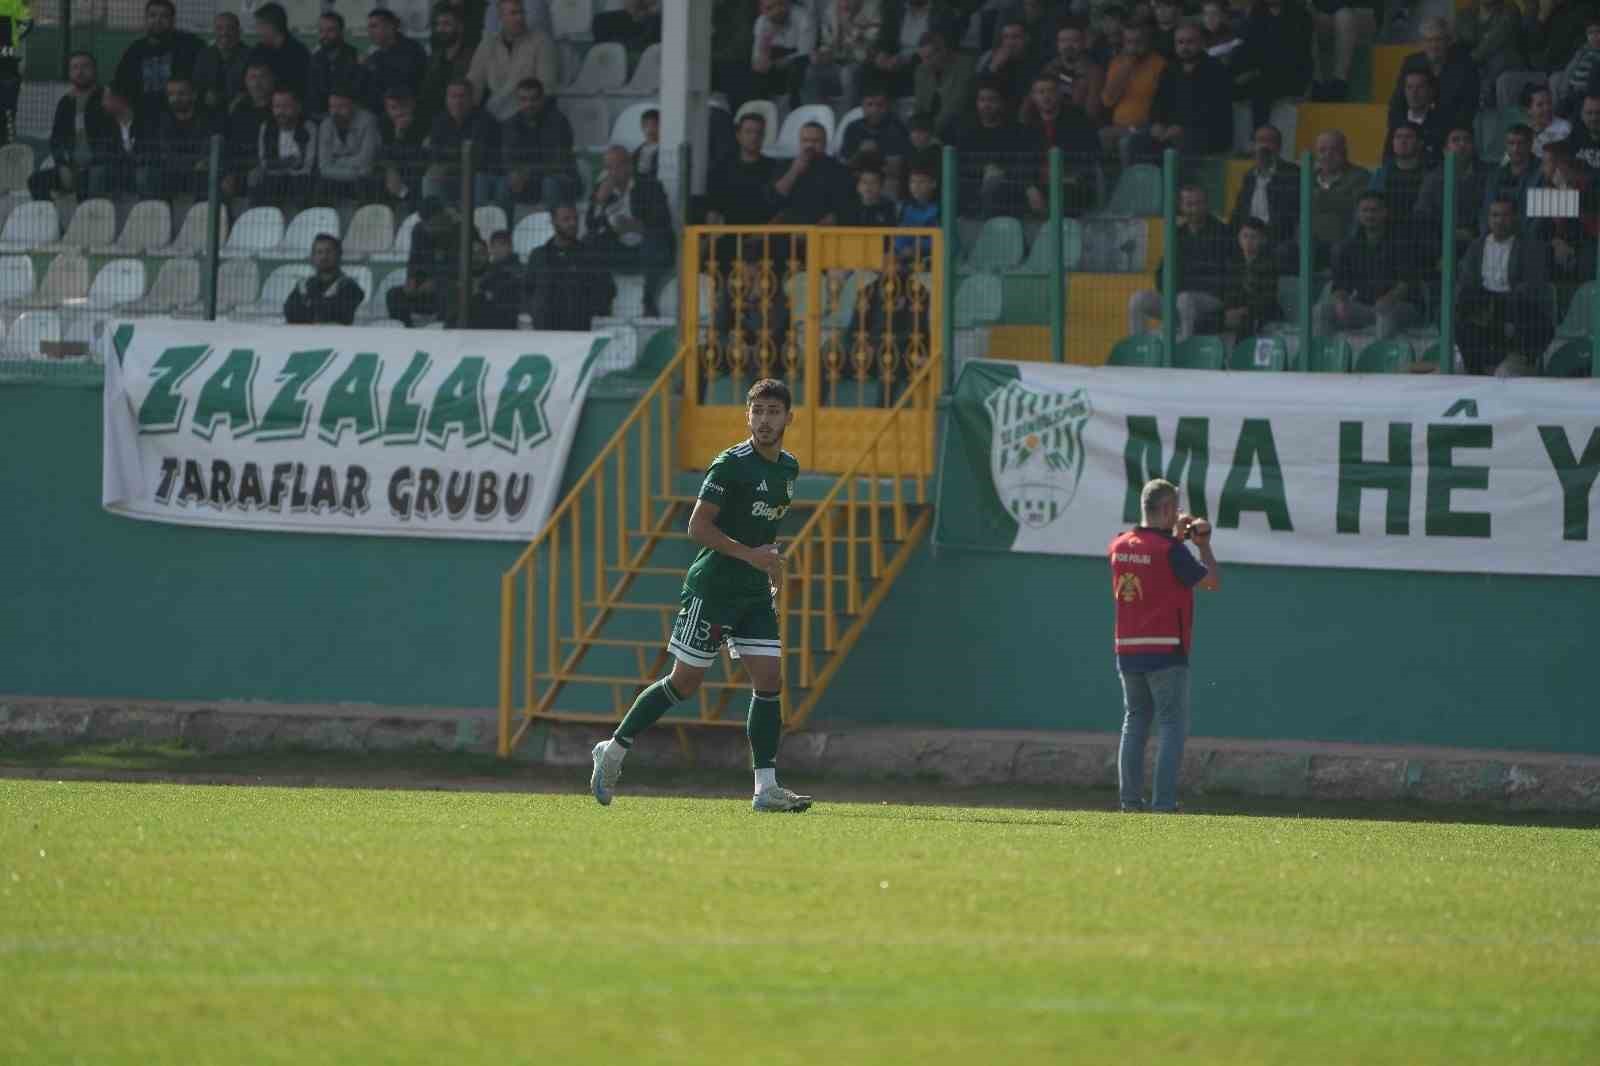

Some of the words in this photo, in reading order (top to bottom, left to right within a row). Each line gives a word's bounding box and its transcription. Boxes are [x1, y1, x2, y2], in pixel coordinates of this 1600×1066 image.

[138, 344, 557, 453] ZAZALAR
[155, 457, 371, 516] TARAFLAR
[386, 466, 534, 522] GRUBU
[1123, 415, 1294, 531] MA
[1336, 398, 1493, 538] HÊ
